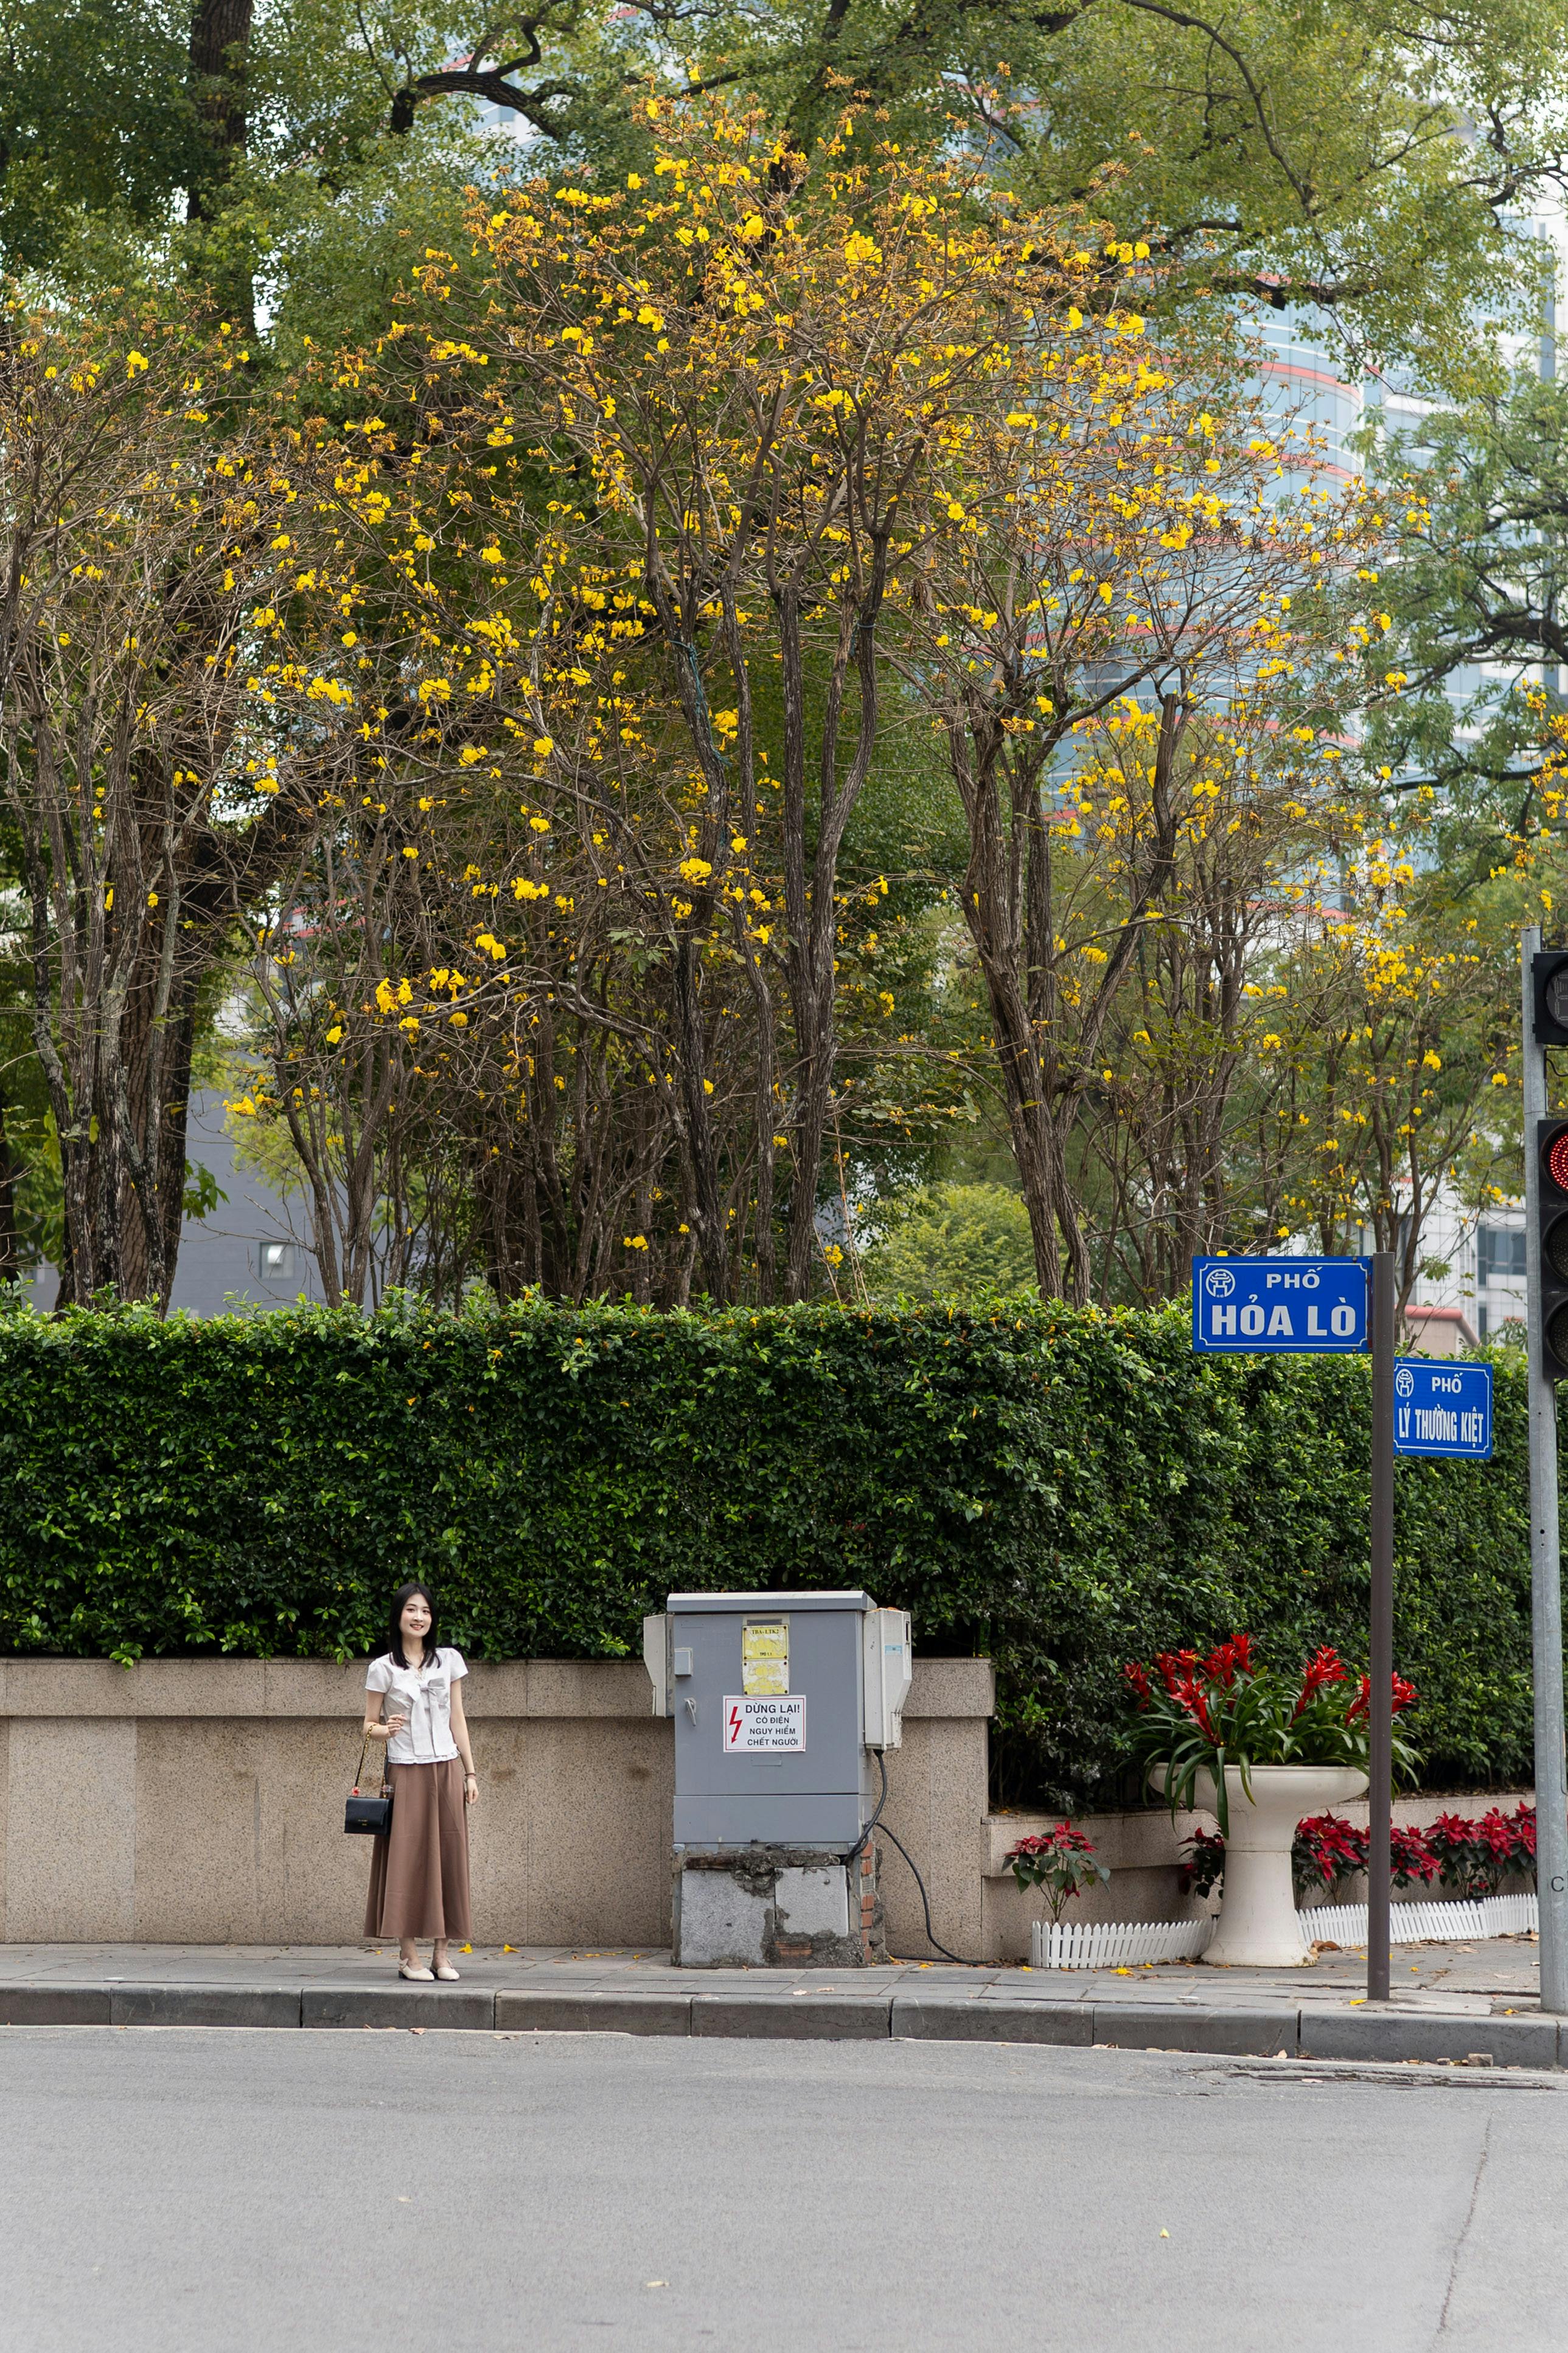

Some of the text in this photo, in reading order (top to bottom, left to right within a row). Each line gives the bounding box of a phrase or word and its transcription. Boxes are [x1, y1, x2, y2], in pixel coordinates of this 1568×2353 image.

[1266, 1266, 1323, 1289] PHỐ
[1211, 1294, 1356, 1337] HỎA LÒ
[1431, 1372, 1463, 1394] PHỐ
[1398, 1401, 1484, 1448] LÝ THƯỜNG KIỆT
[745, 1702, 800, 1715] DỪNG LẠI!
[770, 1715, 790, 1725] ĐIỆN
[775, 1724, 796, 1735] HIỂM
[747, 1736, 770, 1746] CHẾT
